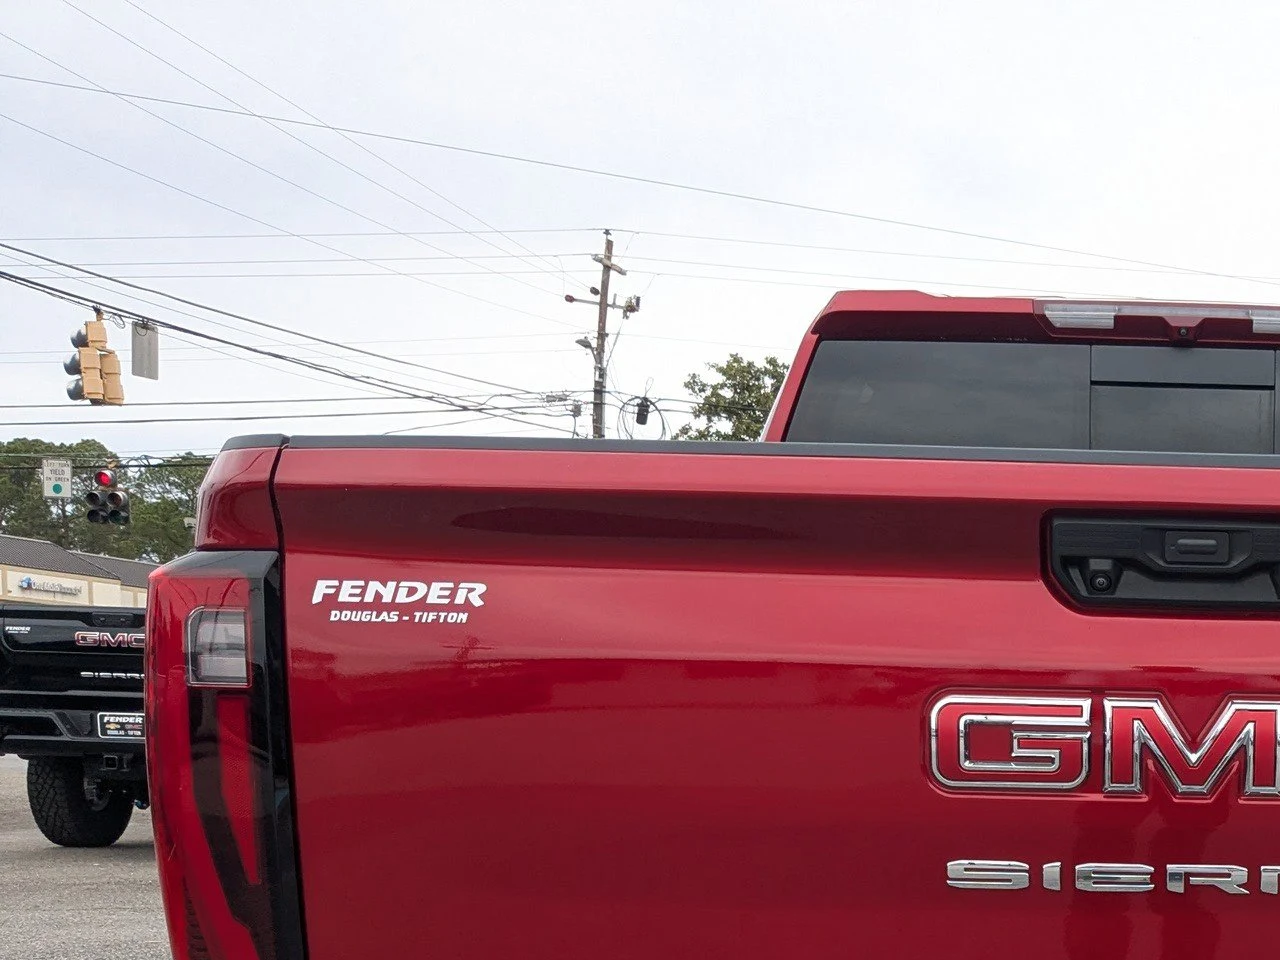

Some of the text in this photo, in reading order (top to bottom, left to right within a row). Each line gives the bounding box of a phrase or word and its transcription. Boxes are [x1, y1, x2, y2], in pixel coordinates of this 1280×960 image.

[312, 579, 488, 608] FENDER
[329, 610, 400, 623] DOUGLAS
[413, 611, 469, 624] TIFTON
[74, 631, 145, 648] GMC
[80, 671, 145, 679] SIERR
[103, 716, 143, 724] FENDER
